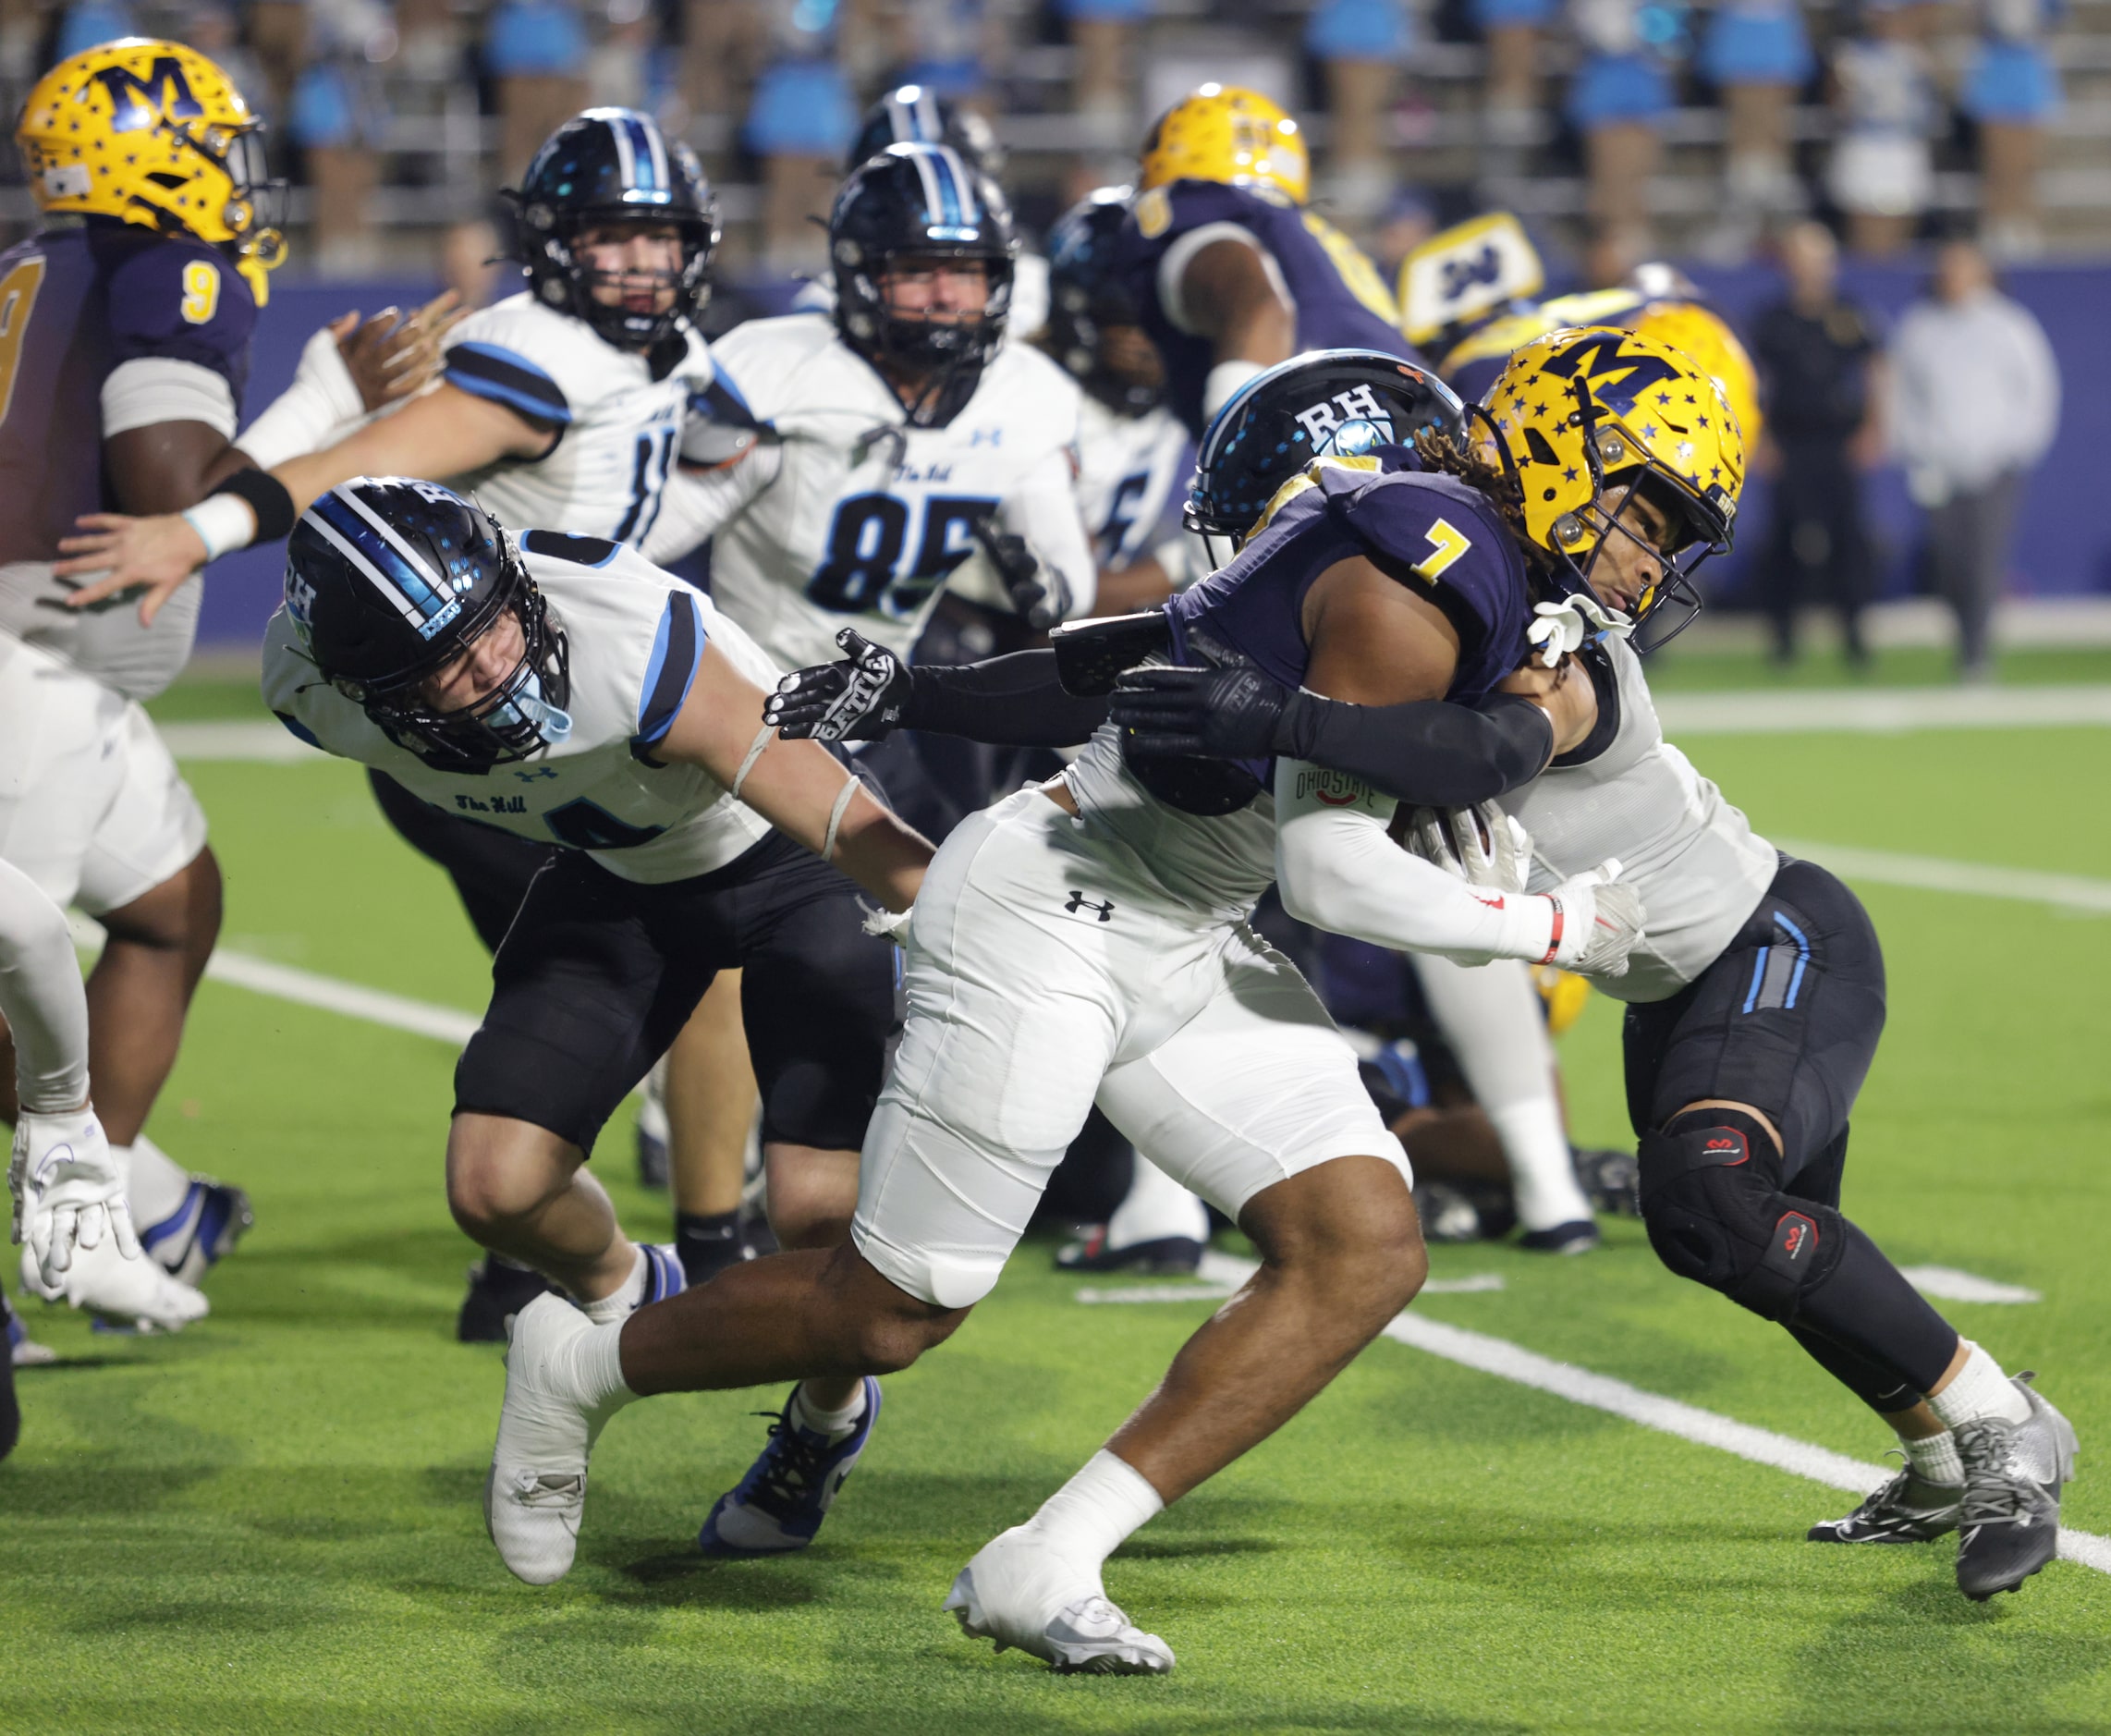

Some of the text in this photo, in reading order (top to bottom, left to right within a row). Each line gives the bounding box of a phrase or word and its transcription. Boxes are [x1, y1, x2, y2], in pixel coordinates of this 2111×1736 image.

[96, 57, 203, 133] M
[181, 259, 221, 324] 9
[1539, 330, 1683, 418] M
[1294, 383, 1390, 454] RH
[803, 490, 1002, 617] 85
[1409, 517, 1472, 587] 7
[814, 654, 889, 740] BATTLE
[455, 794, 528, 813] The Hill
